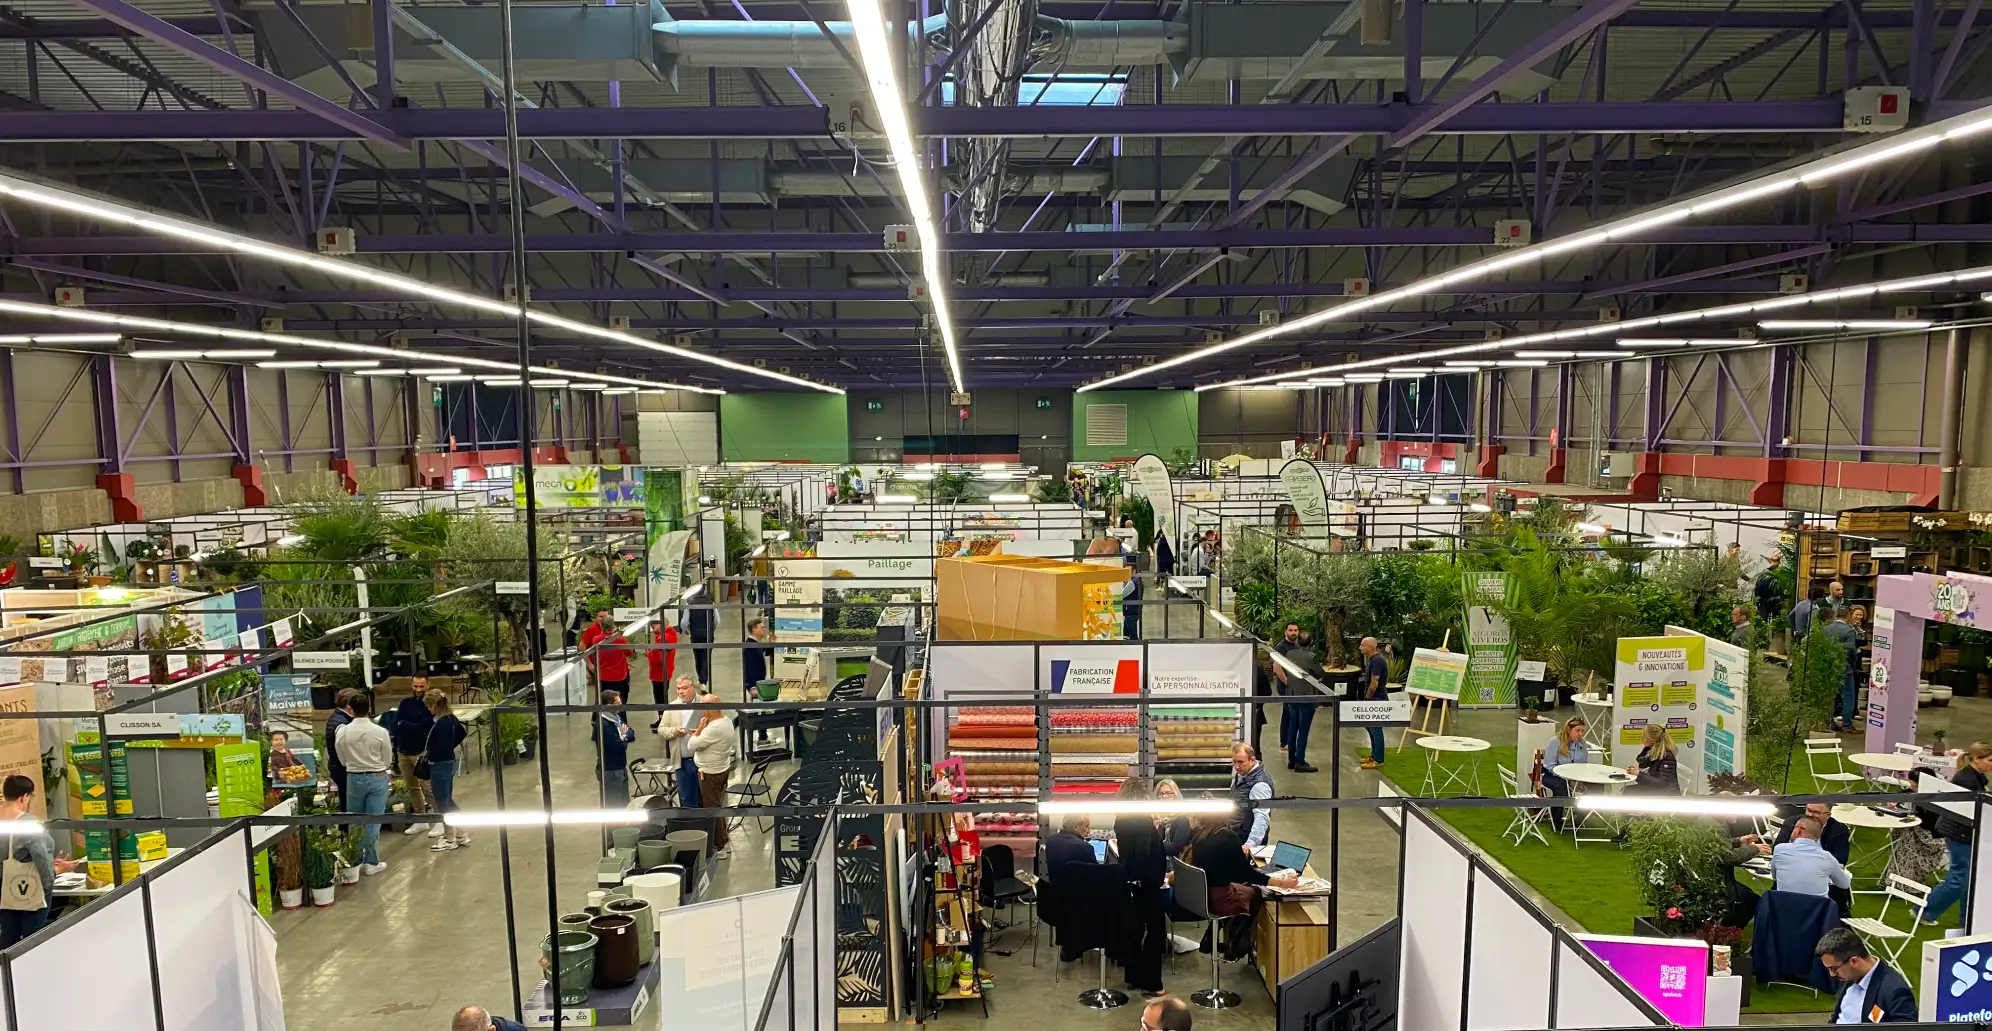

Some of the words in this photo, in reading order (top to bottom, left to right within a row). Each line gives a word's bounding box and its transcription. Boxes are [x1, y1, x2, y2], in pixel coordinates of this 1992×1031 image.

[1859, 115, 1872, 125] 15
[833, 122, 846, 132] 16
[868, 559, 913, 570] Paillage
[1937, 583, 1951, 599] 20
[1936, 599, 1951, 611] ANS
[1641, 649, 1682, 659] NOUVEAUTÉS
[1644, 661, 1685, 671] INNOVATIONS
[1069, 668, 1114, 676] FABRICATION
[1875, 667, 1884, 676] 20
[1072, 677, 1112, 686] FRANÇAISE
[1171, 675, 1198, 683] expertise
[1151, 682, 1162, 690] LA
[1163, 682, 1240, 690] PERSONNALISATION
